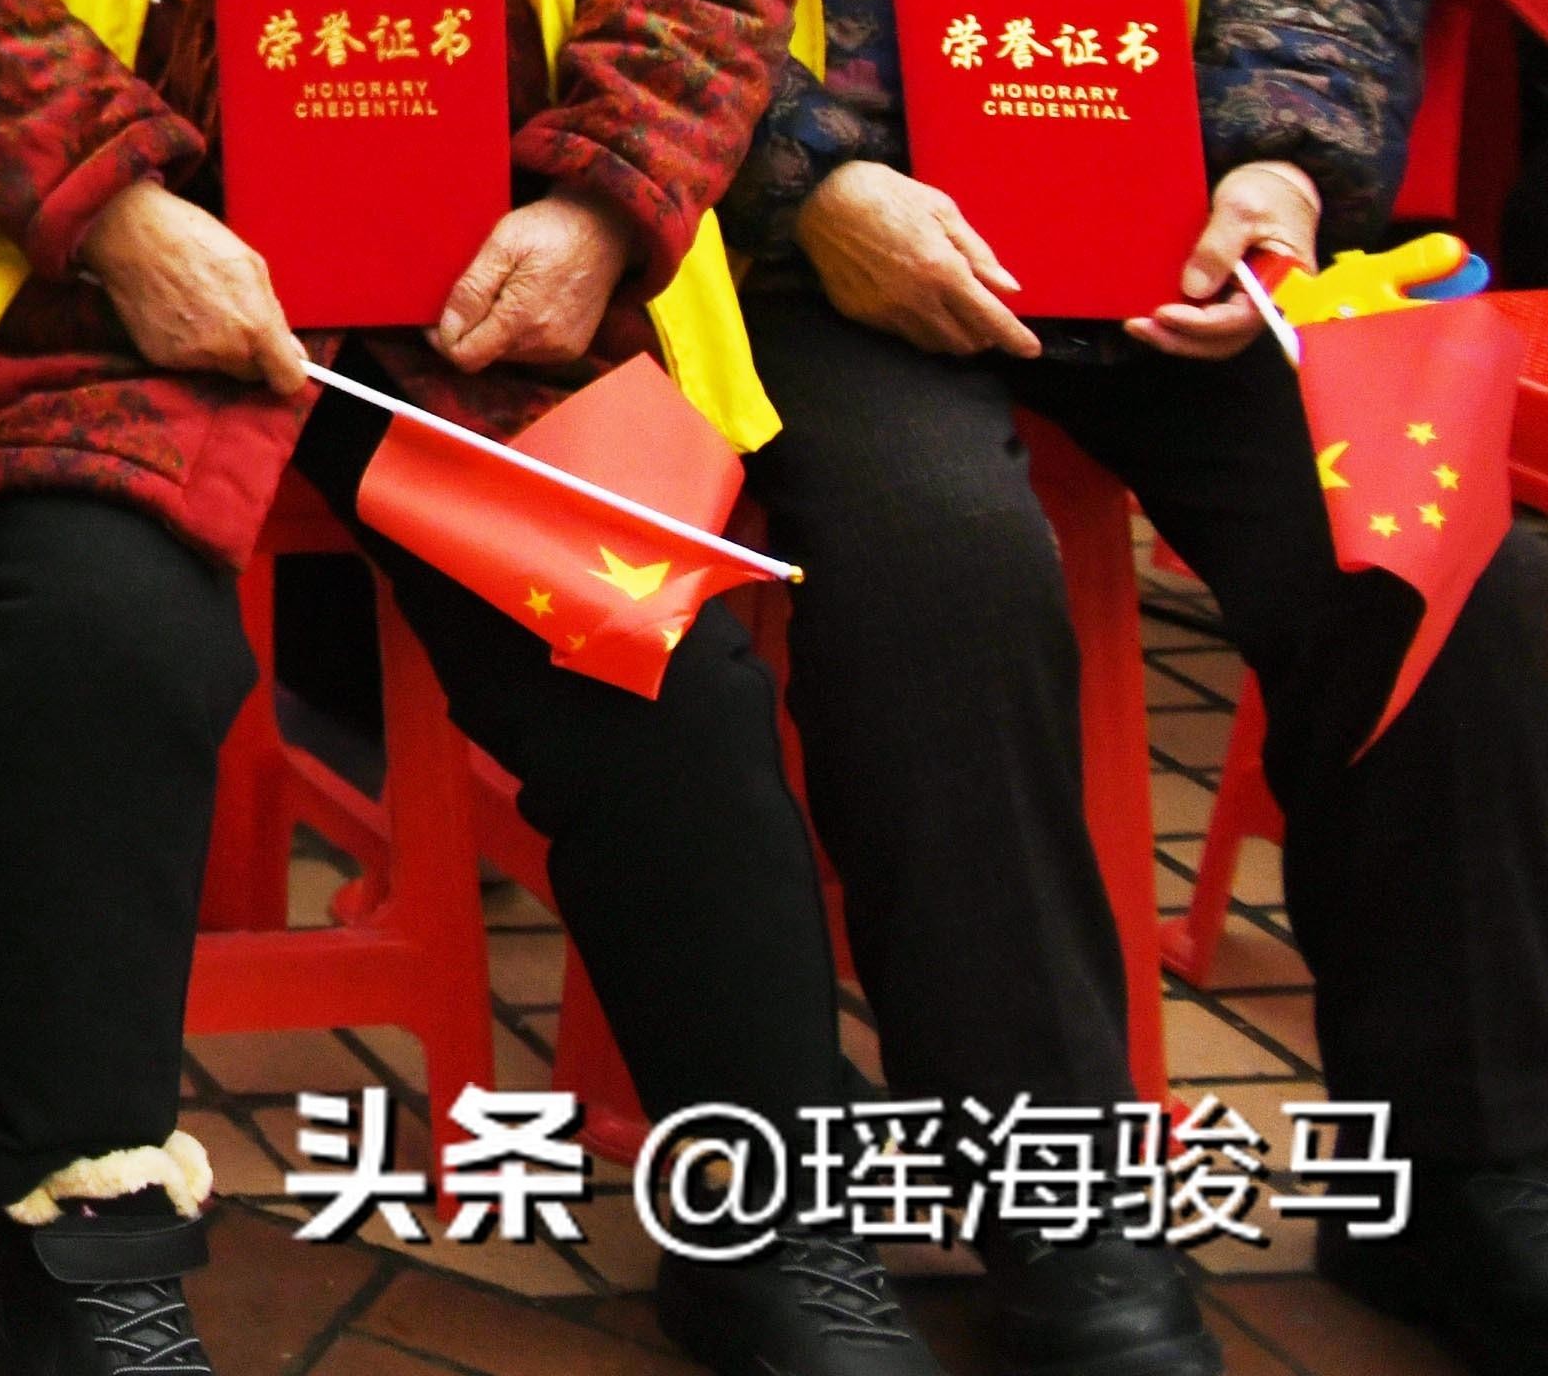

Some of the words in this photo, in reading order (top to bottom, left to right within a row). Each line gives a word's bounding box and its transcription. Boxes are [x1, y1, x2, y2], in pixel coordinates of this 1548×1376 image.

[258, 8, 472, 70] 荣誉证书
[941, 13, 1159, 74] 荣誉证书
[303, 80, 428, 99] HONORARY
[990, 83, 1119, 101] HONORARY
[294, 100, 439, 118] CREDENTIAL
[982, 100, 1132, 121] CREDENTIAL
